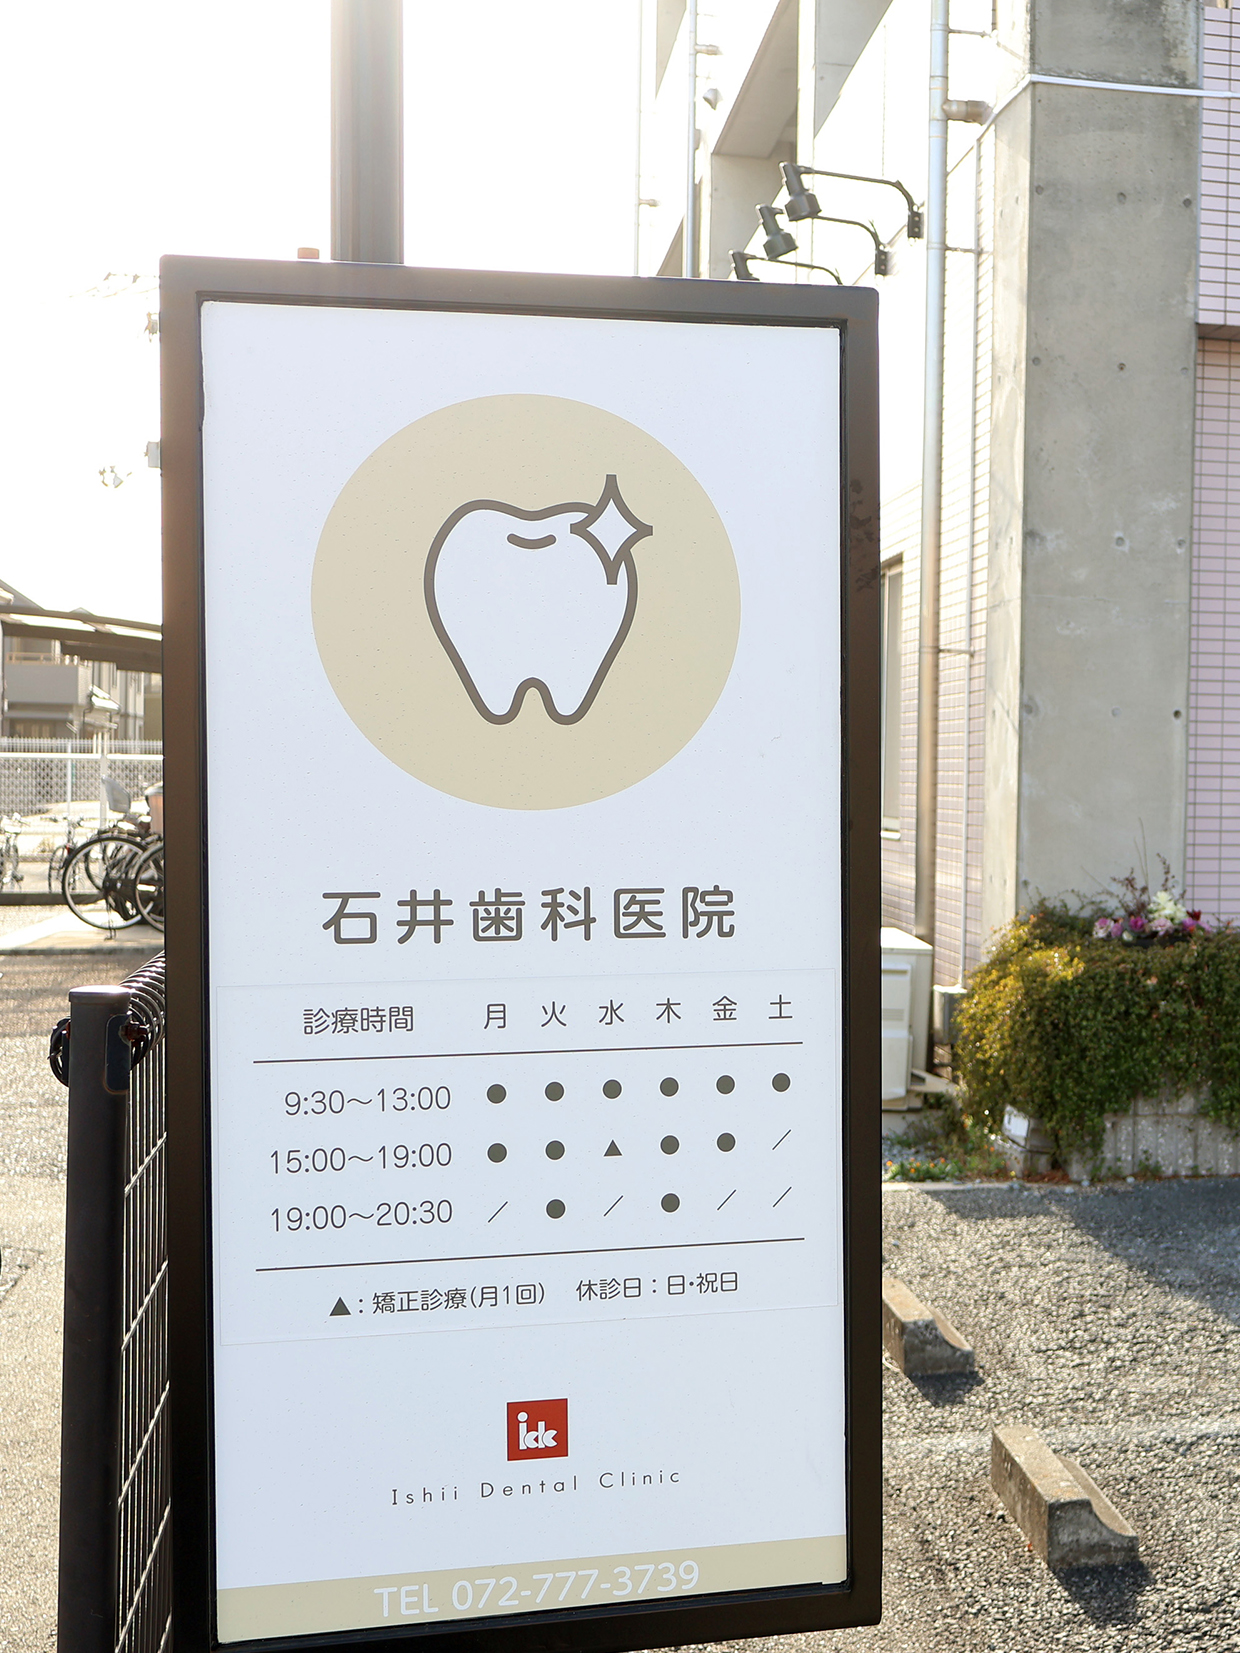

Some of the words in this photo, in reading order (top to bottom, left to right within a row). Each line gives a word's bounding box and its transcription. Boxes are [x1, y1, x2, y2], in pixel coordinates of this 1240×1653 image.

[322, 885, 735, 944] 石井歯科医院
[303, 1006, 413, 1034] 診療時間
[484, 1004, 506, 1029] 月
[541, 1001, 566, 1027] 火
[599, 1000, 624, 1025] 水
[656, 998, 681, 1023] 木
[713, 996, 737, 1020] 金
[769, 995, 792, 1019] 土
[285, 1086, 450, 1115] 9:30～13:00
[271, 1143, 451, 1174] 15:00～19:00
[272, 1200, 452, 1231] 19:00～20:30
[392, 1487, 457, 1505] Ishii
[481, 1476, 576, 1497] Dental
[600, 1470, 679, 1488] Clinic
[374, 1583, 438, 1618] TEL
[452, 1560, 699, 1611] 072-777-3739
